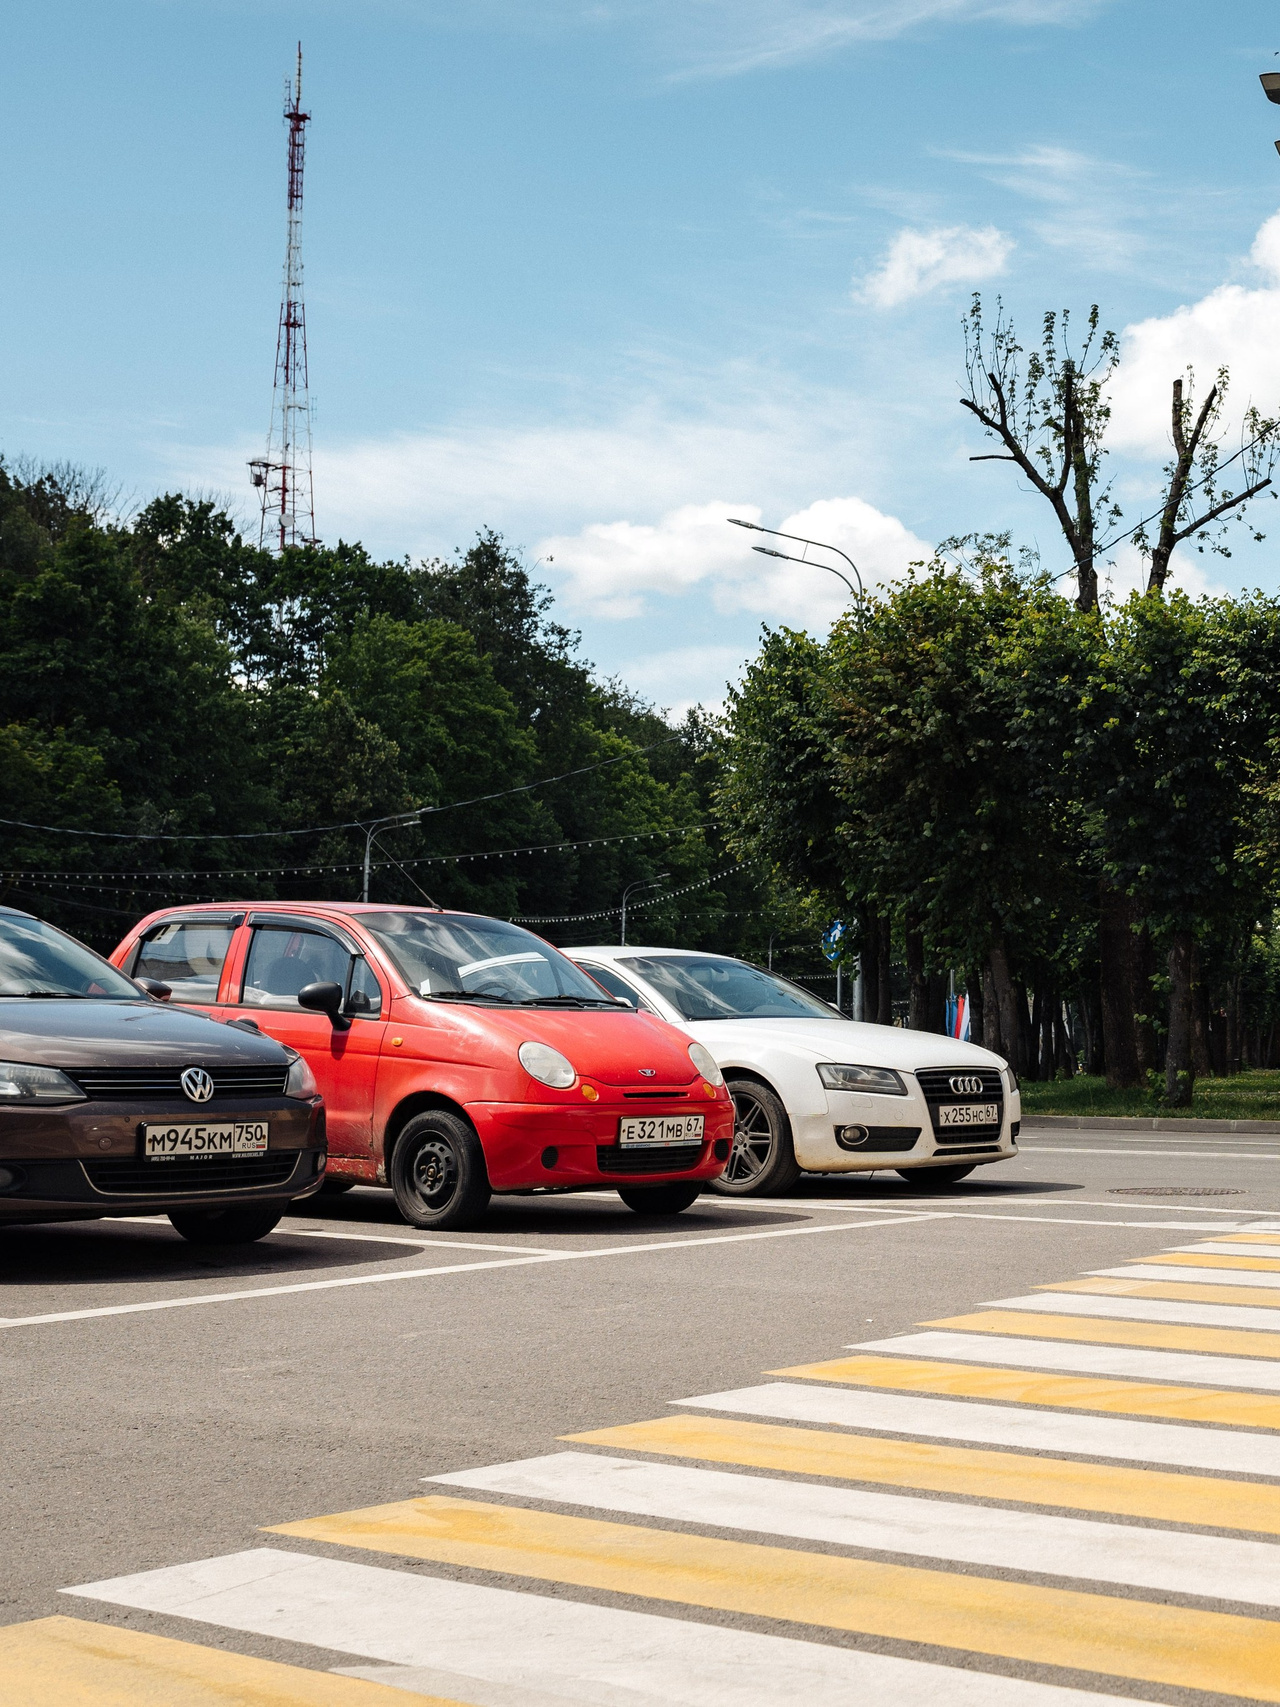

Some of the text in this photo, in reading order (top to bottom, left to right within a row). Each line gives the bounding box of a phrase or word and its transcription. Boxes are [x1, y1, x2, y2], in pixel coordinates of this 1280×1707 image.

[944, 1105, 995, 1124] Х255НС 67
[151, 1124, 264, 1152] М945КМ 750
[626, 1118, 700, 1140] Е321МВ 67
